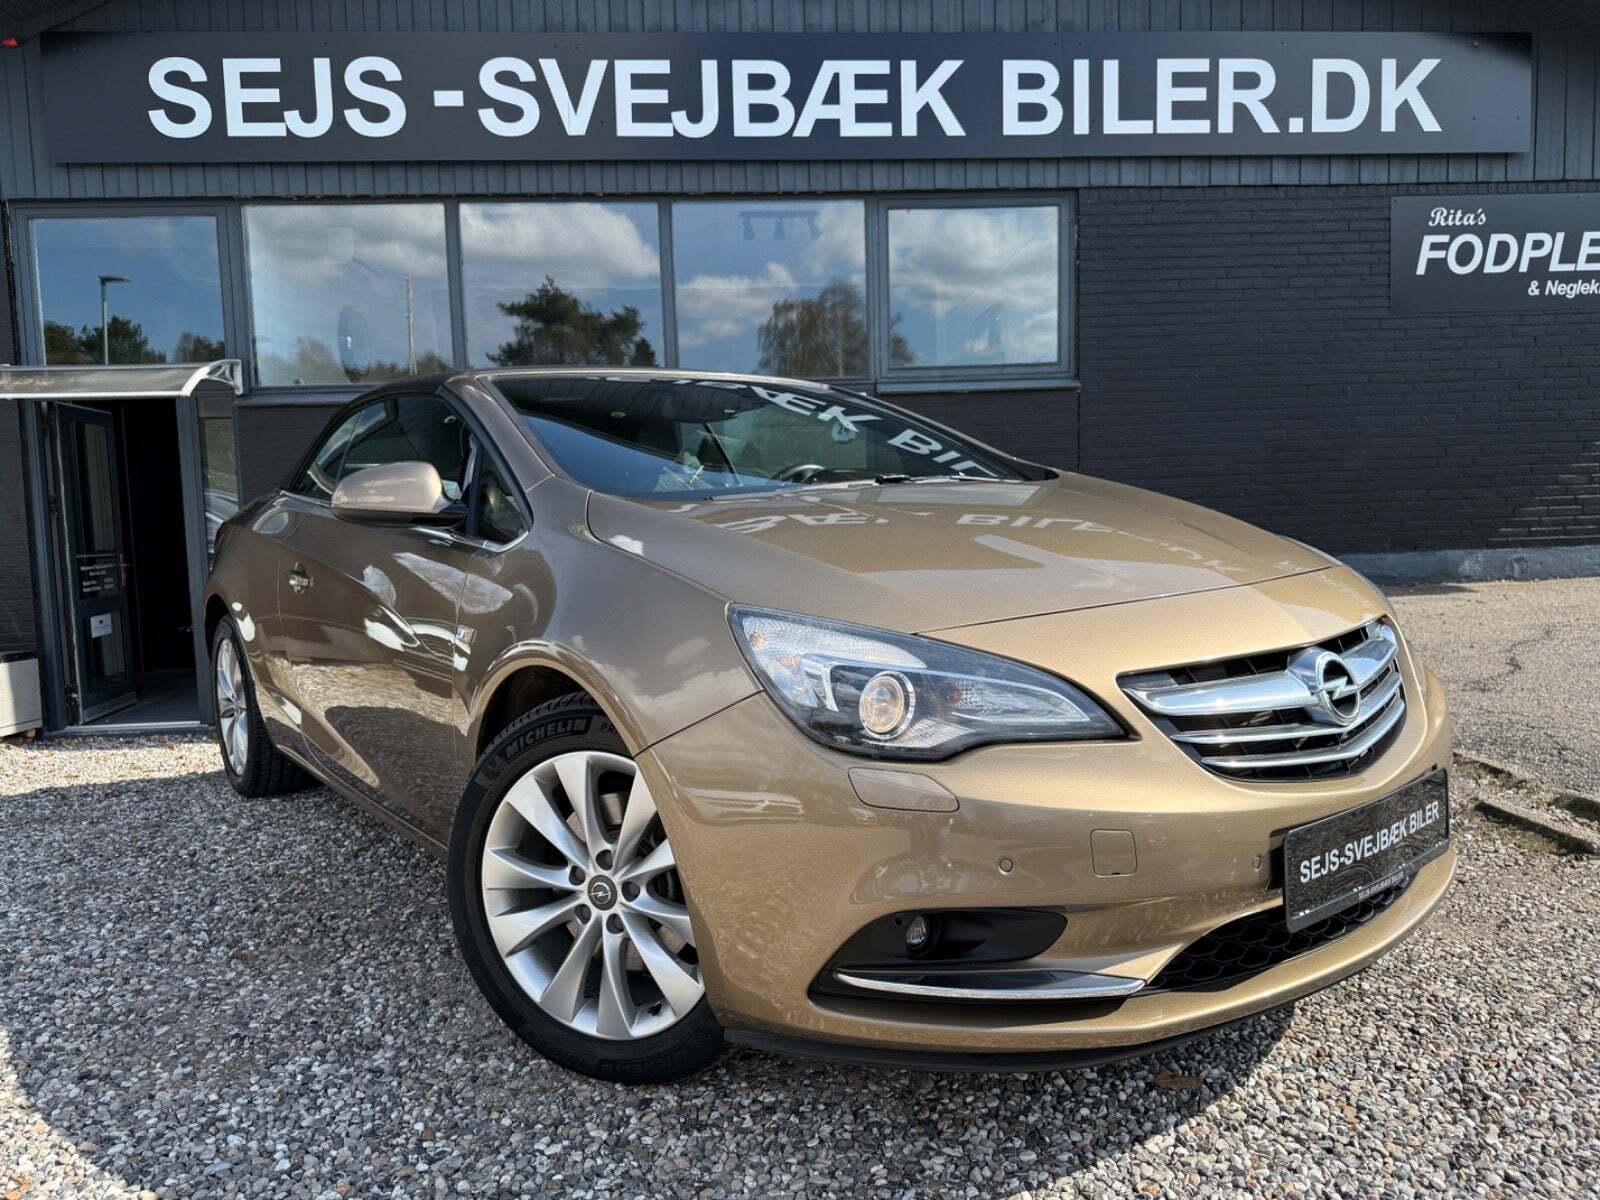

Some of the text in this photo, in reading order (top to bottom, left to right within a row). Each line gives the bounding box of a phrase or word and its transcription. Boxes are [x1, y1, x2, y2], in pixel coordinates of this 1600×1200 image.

[147, 56, 406, 138] SEJS
[1001, 58, 1442, 136] BILER.DK
[1428, 207, 1487, 226] Rita's
[1528, 279, 1600, 298] & Neglek
[505, 718, 588, 758] MICHELIN
[1300, 801, 1440, 884] SEJS-SVEJBÆK BILER
